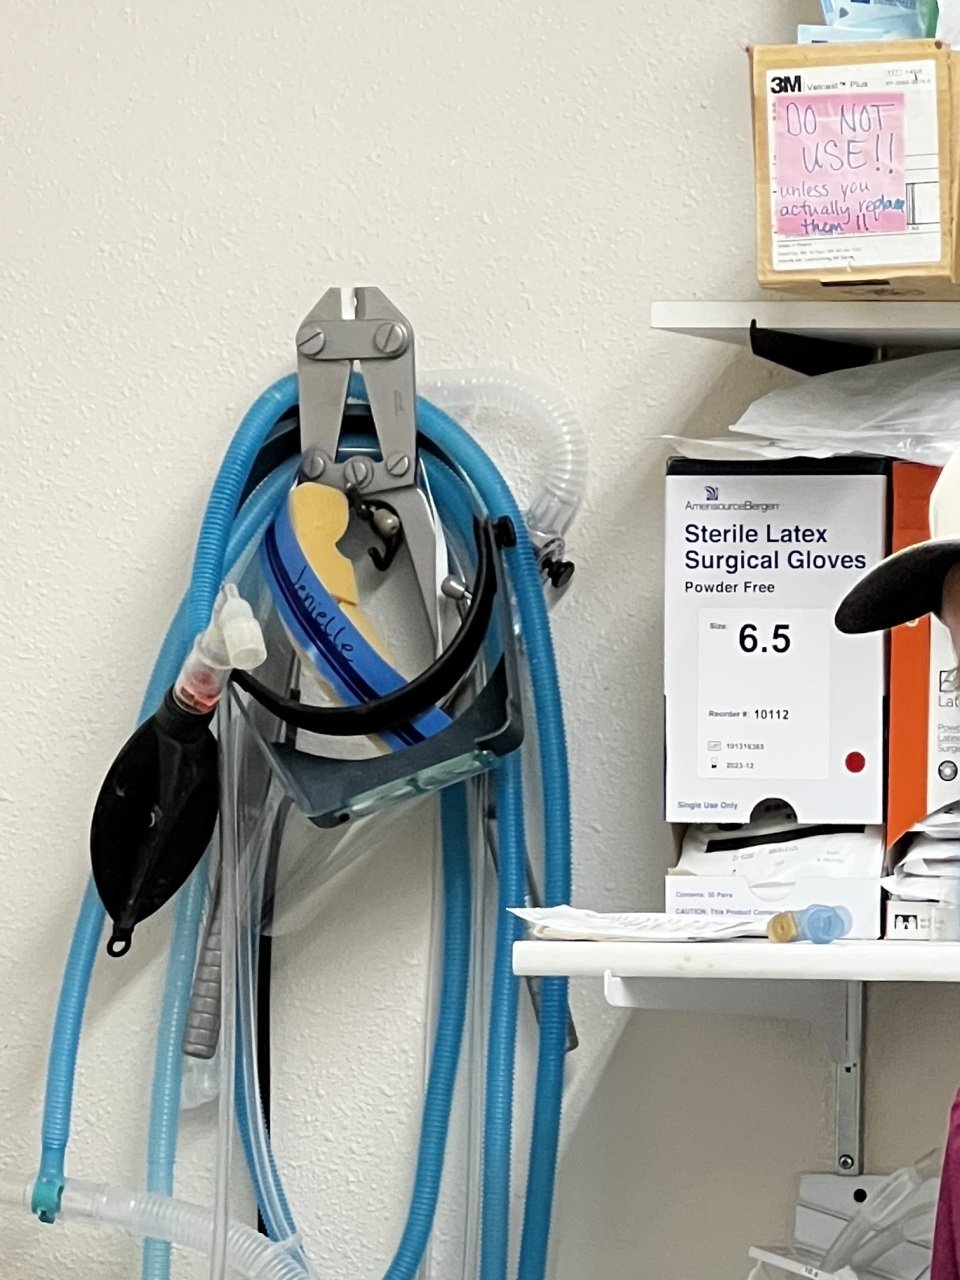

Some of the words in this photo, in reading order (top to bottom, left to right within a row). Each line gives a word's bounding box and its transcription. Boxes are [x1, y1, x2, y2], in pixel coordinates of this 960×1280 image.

[770, 76, 802, 94] 3M
[850, 80, 868, 88] Plus
[786, 101, 817, 136] DO
[840, 103, 895, 134] NOT
[802, 132, 894, 174] USE!!
[780, 181, 829, 199] unless
[840, 182, 871, 200] you
[780, 200, 851, 225] actually
[685, 500, 780, 513] AmerisourceBergen
[685, 523, 758, 543] Sterile
[767, 524, 828, 543] Latex
[685, 550, 779, 574] Surgical
[787, 550, 867, 569] Gloves
[685, 581, 738, 593] Powder
[744, 581, 775, 593] Free
[739, 623, 791, 653] 6.5
[754, 709, 789, 720] 10112
[678, 801, 701, 811] Single
[720, 802, 738, 811] Only
